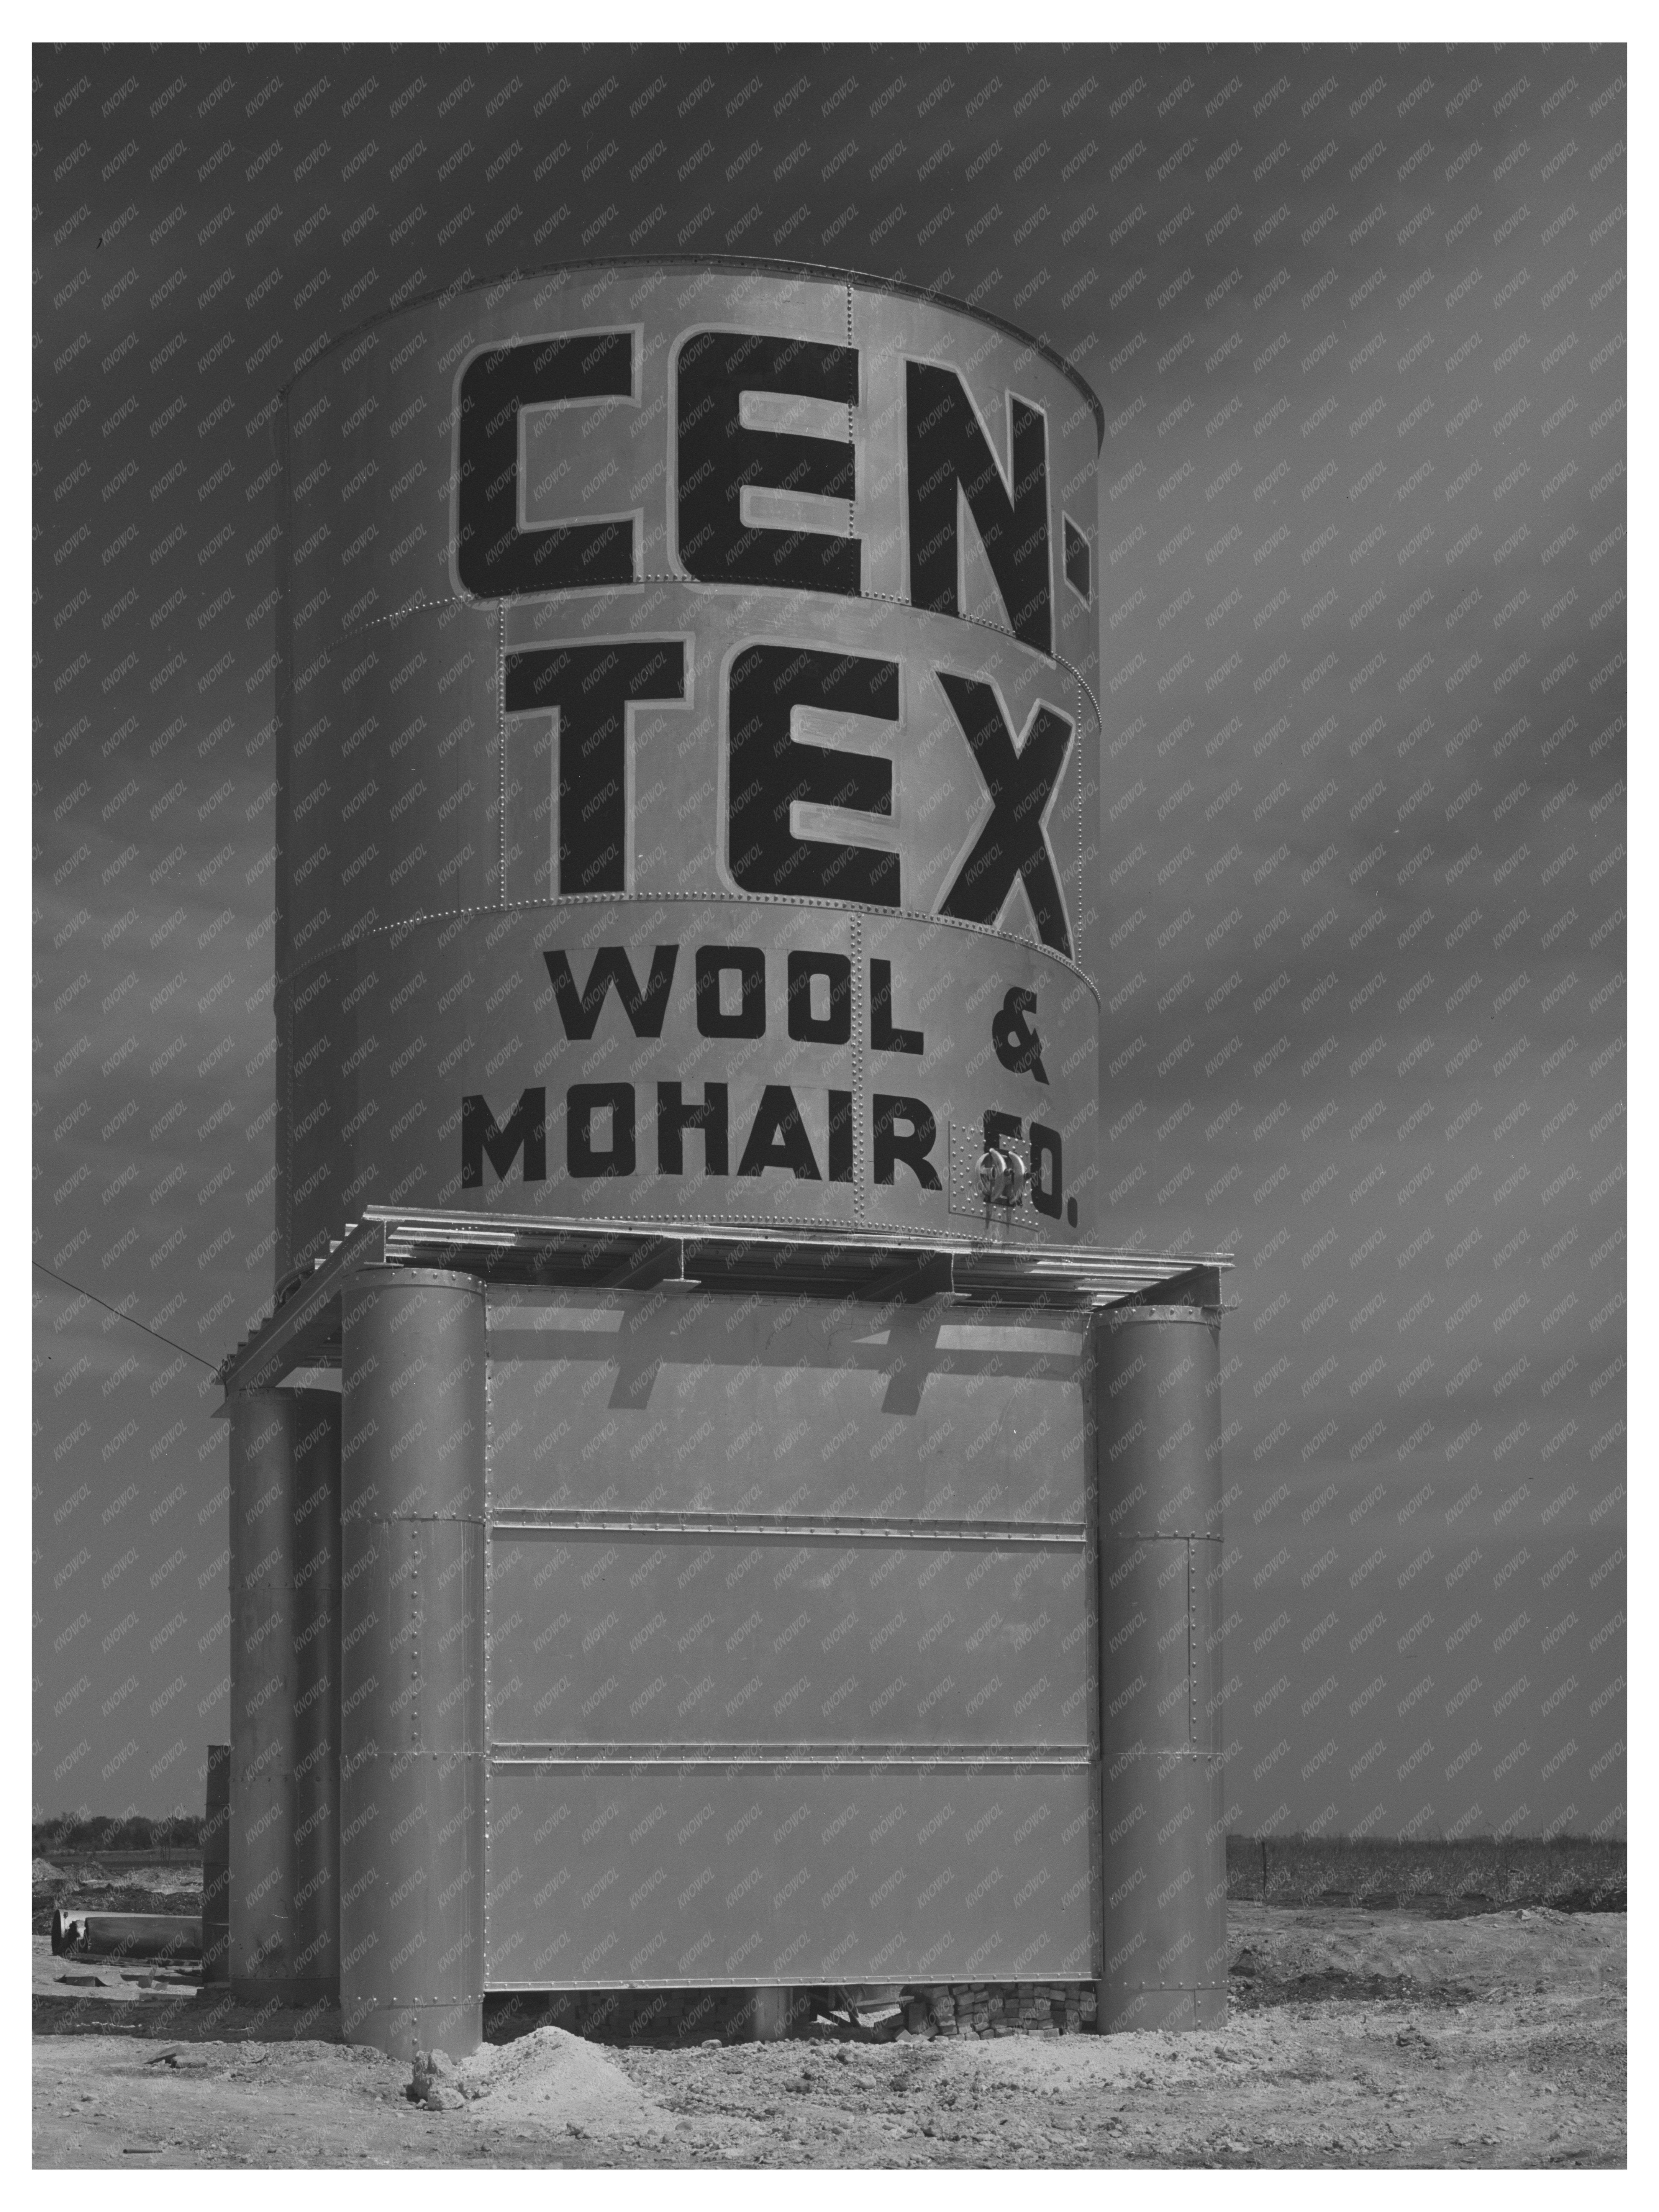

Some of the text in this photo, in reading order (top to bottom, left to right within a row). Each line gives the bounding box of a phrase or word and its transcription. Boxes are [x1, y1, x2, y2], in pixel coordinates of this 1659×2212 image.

[457, 331, 1090, 655] CEN-
[505, 641, 1074, 962] TEX
[543, 944, 1050, 1085] WOOL &
[461, 1081, 943, 1191] MOHAIR
